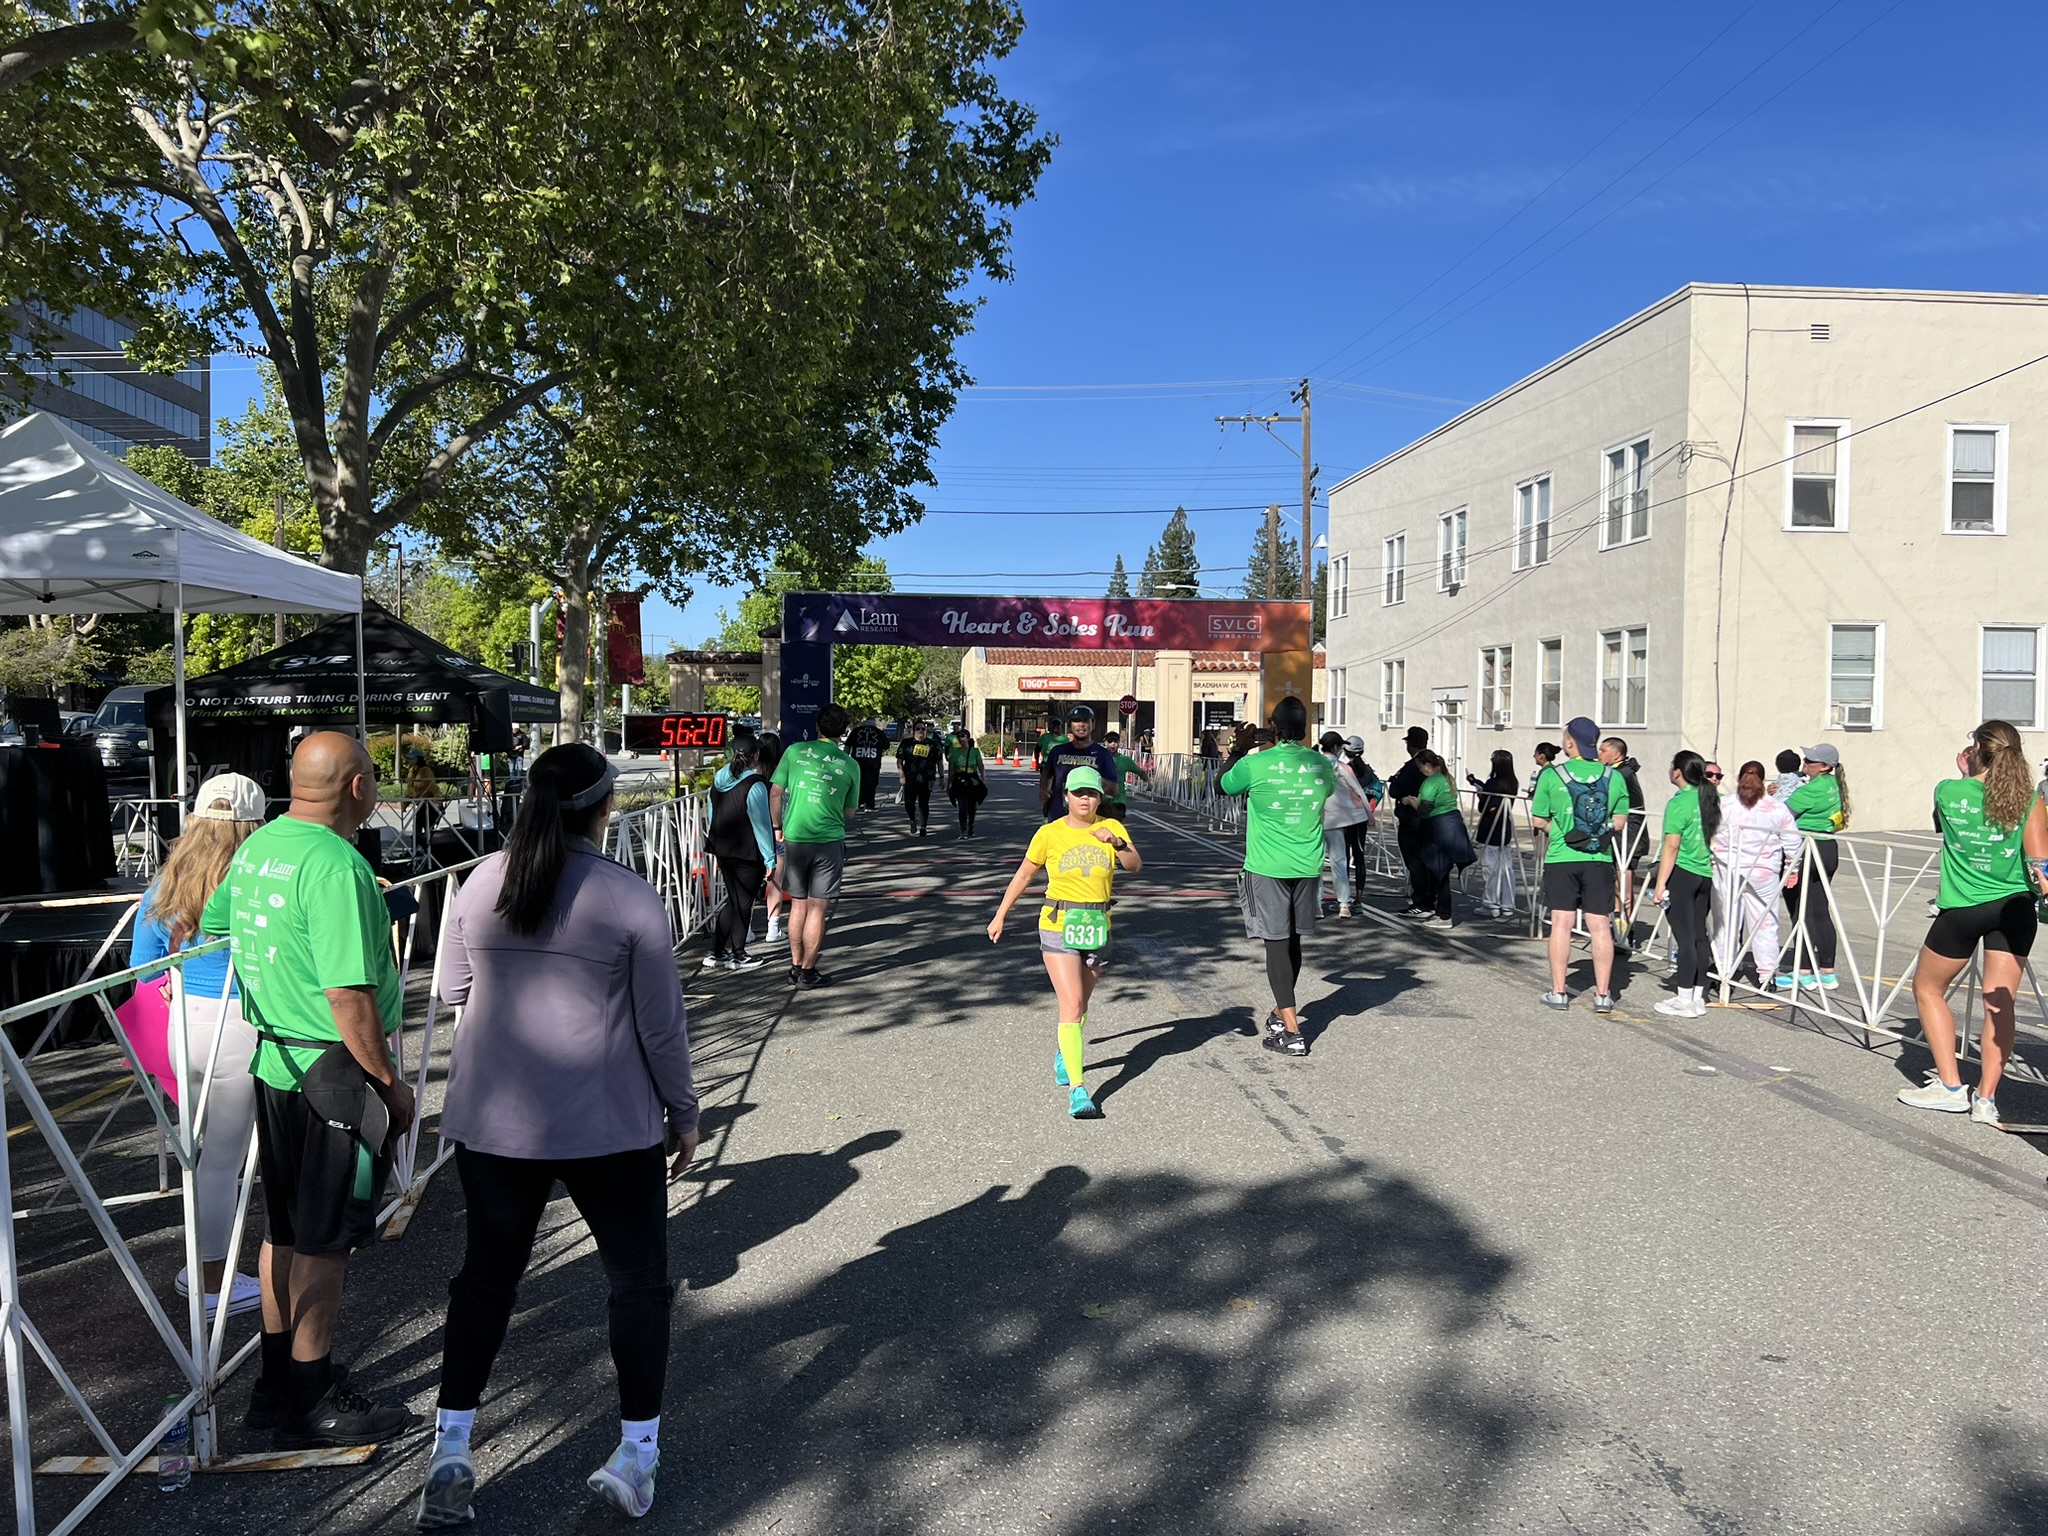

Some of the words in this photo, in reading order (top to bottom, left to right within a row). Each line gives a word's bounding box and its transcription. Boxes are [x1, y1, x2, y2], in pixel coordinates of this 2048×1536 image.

[860, 607, 898, 626] Lam
[941, 610, 1012, 635] Heart
[1016, 611, 1037, 635] &
[1042, 612, 1098, 636] Soles
[1103, 613, 1155, 637] Run
[1213, 618, 1258, 631] SVLG
[1021, 679, 1049, 689] TOGO'S
[200, 697, 232, 706] NOT
[234, 695, 291, 706] DISTURB
[295, 694, 345, 704] TIMING
[349, 692, 402, 703] DURING
[406, 691, 450, 701] EVENT
[1120, 701, 1137, 709] STOP
[191, 709, 221, 718] Find
[224, 708, 268, 717] results
[272, 707, 286, 716] at
[290, 703, 433, 716] www.SVEiming.com
[660, 717, 724, 746] 56:20
[855, 747, 877, 759] EMS
[1065, 923, 1104, 946] 6331
